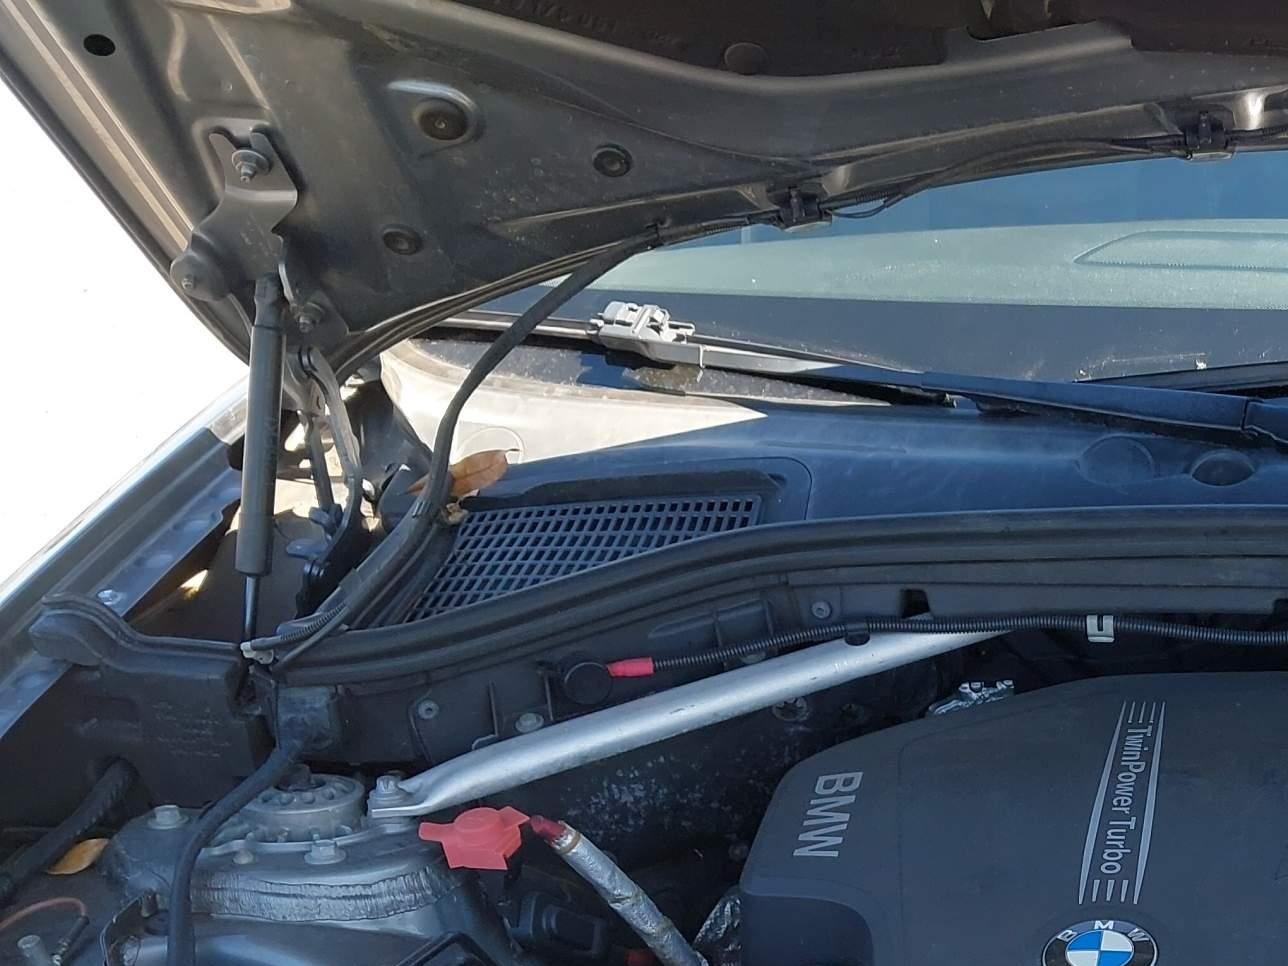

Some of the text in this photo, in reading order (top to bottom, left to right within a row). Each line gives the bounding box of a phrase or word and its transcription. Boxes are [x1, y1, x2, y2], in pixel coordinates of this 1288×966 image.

[793, 771, 864, 857] BMW
[1100, 725, 1153, 874] TwinPower Turbo
[1057, 920, 1150, 942] BMW
